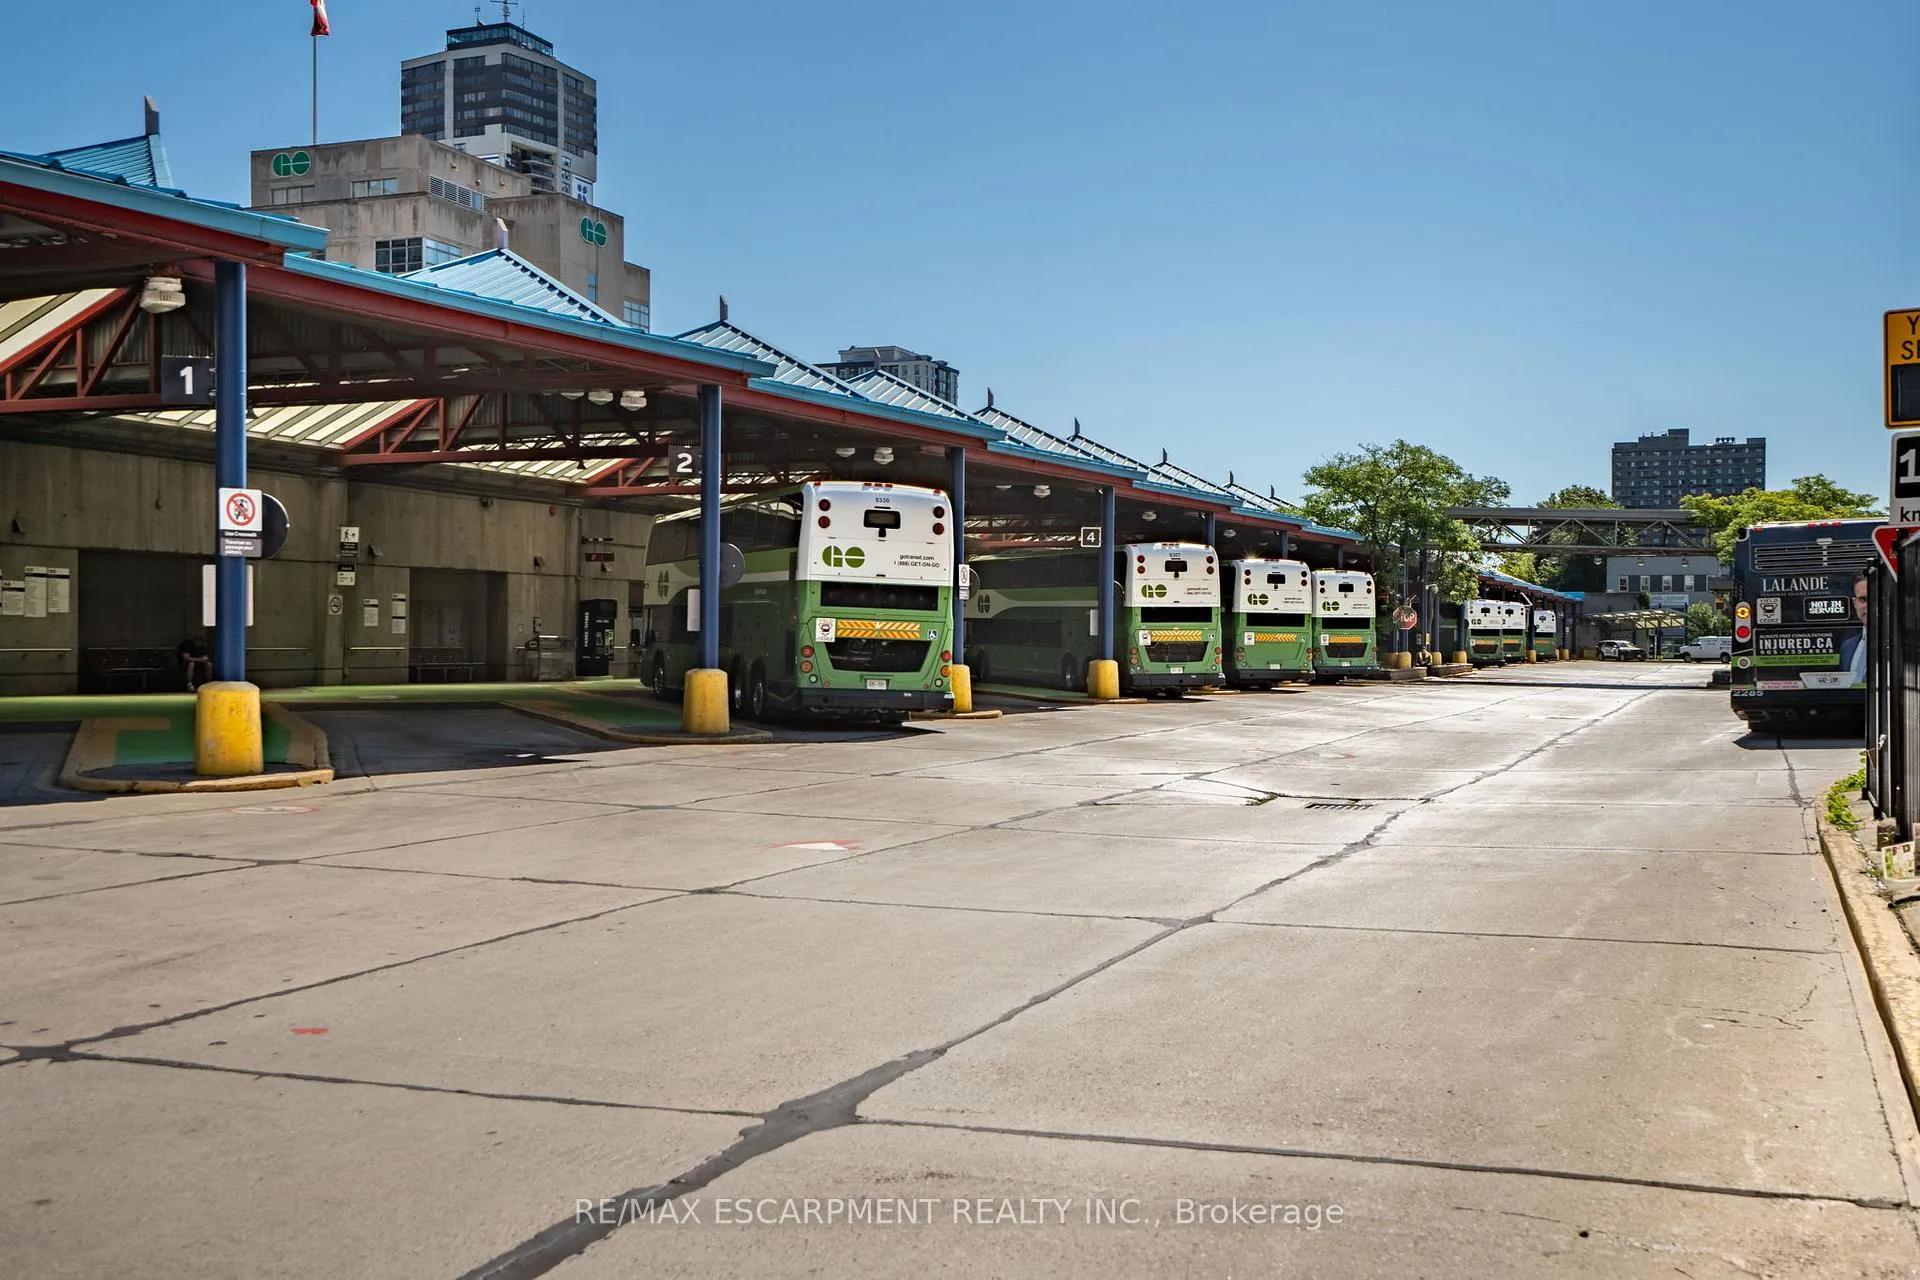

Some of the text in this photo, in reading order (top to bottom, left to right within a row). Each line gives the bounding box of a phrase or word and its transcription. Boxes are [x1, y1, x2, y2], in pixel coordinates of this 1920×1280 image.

[179, 366, 194, 395] 1
[676, 453, 693, 473] 2
[1086, 532, 1096, 543] 4
[822, 545, 865, 568] GO
[1763, 577, 1829, 591] LALANDE
[1141, 584, 1167, 598] GO
[1247, 593, 1269, 606] GO
[1322, 601, 1340, 611] GO
[1829, 600, 1842, 608] IN
[1759, 638, 1833, 649] INJURED.CA
